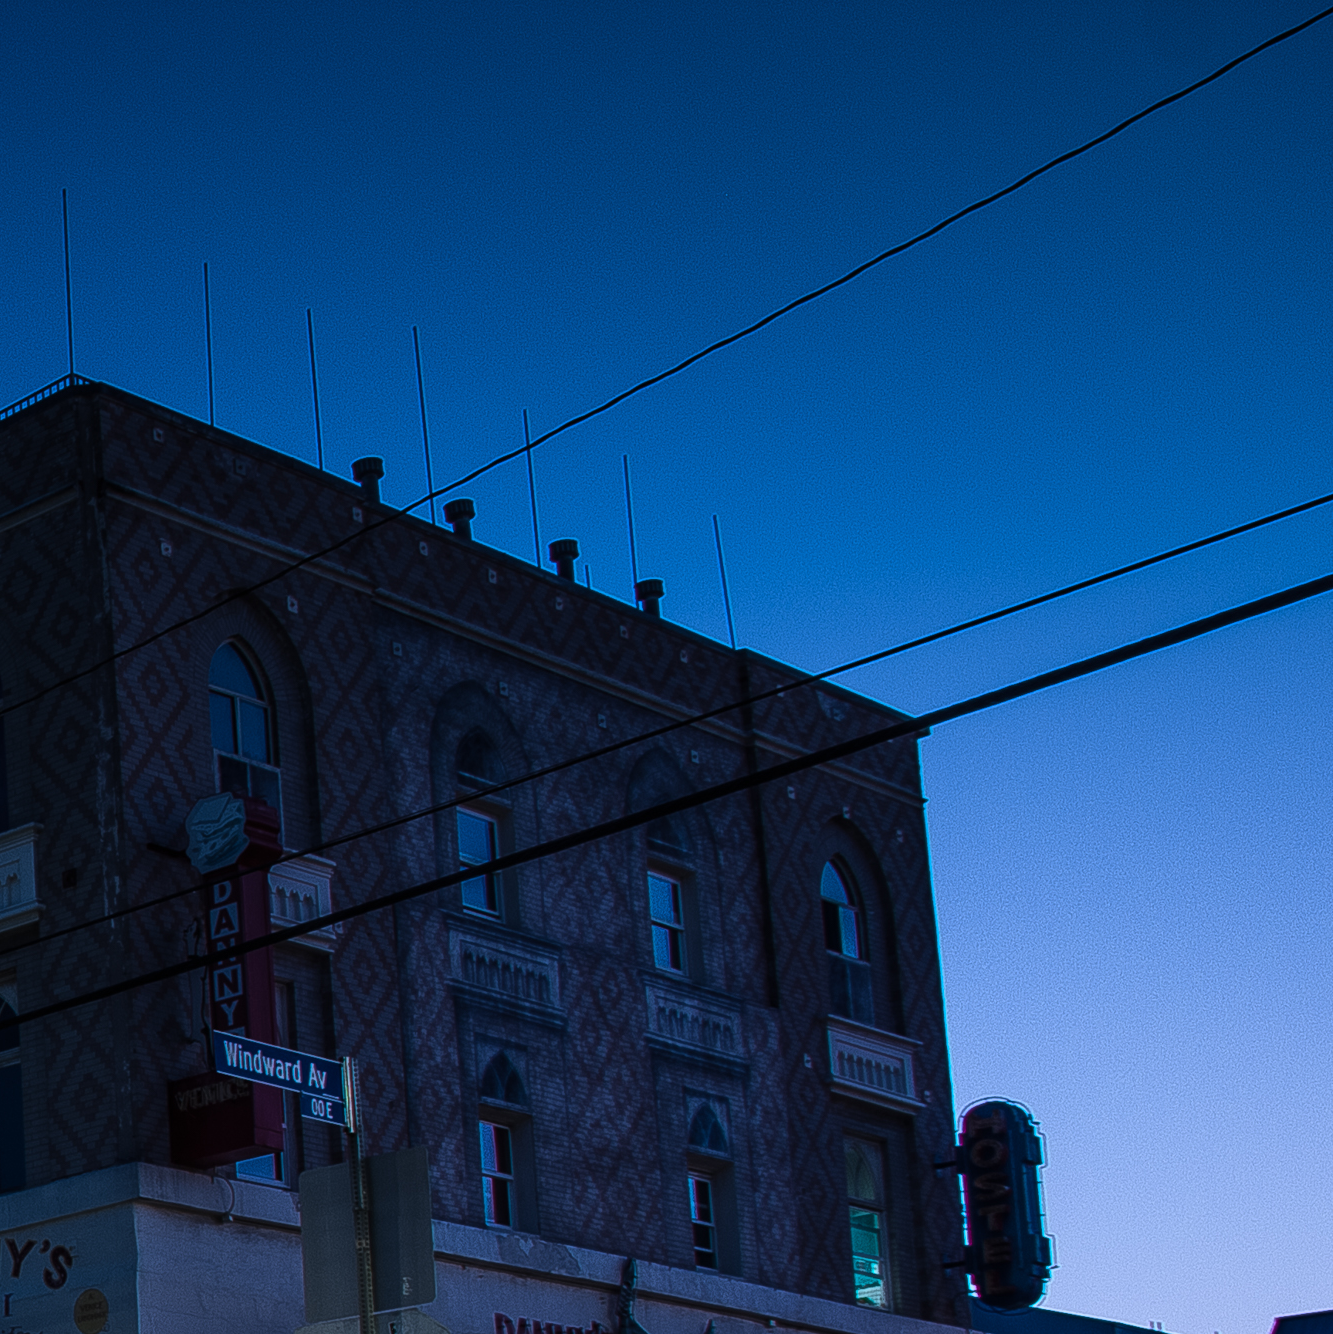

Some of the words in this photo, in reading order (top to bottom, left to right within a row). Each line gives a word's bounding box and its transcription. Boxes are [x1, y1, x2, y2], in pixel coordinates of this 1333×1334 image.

[223, 1040, 303, 1084] Windward
[308, 1062, 328, 1090] Av
[968, 1108, 1015, 1296] HOSTEL
